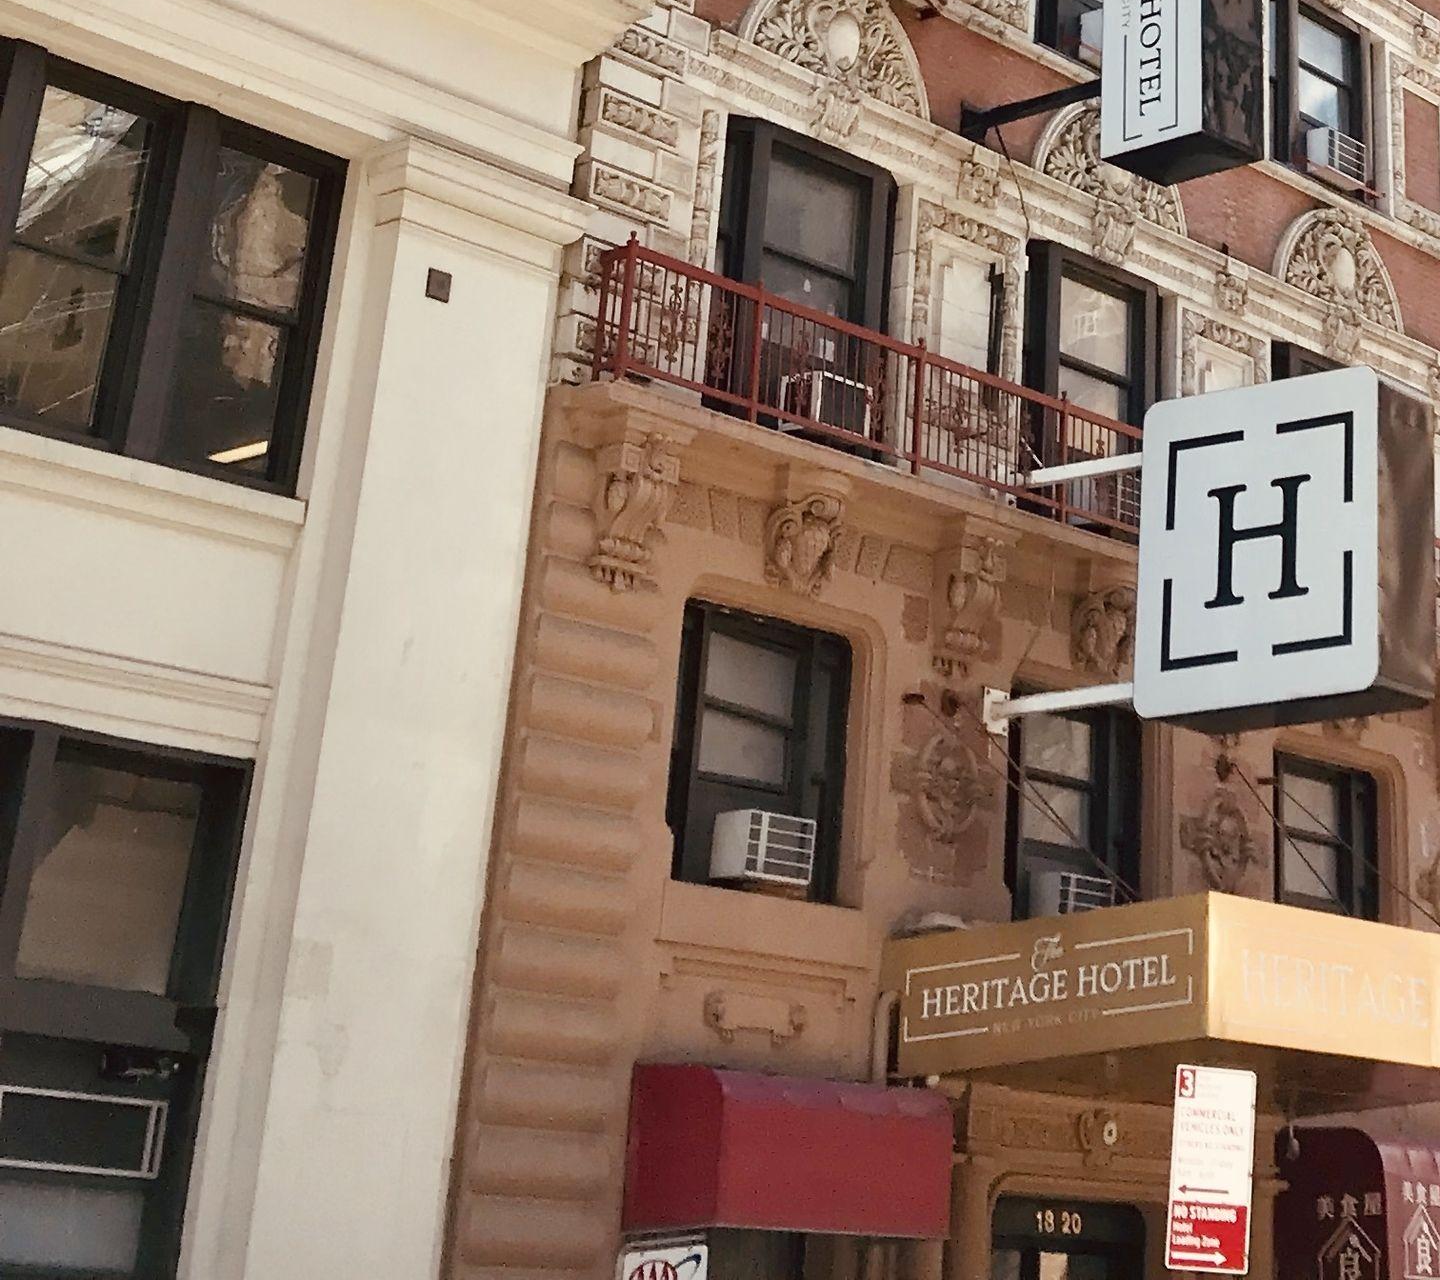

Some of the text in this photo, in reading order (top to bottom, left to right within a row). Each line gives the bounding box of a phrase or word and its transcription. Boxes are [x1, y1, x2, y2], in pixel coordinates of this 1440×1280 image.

[1203, 473, 1311, 609] H
[921, 954, 1176, 1019] HERITAGE HOTEL
[1241, 948, 1429, 1030] HERITAGE
[1180, 1070, 1194, 1097] 3
[1173, 1204, 1237, 1223] NO STANDING
